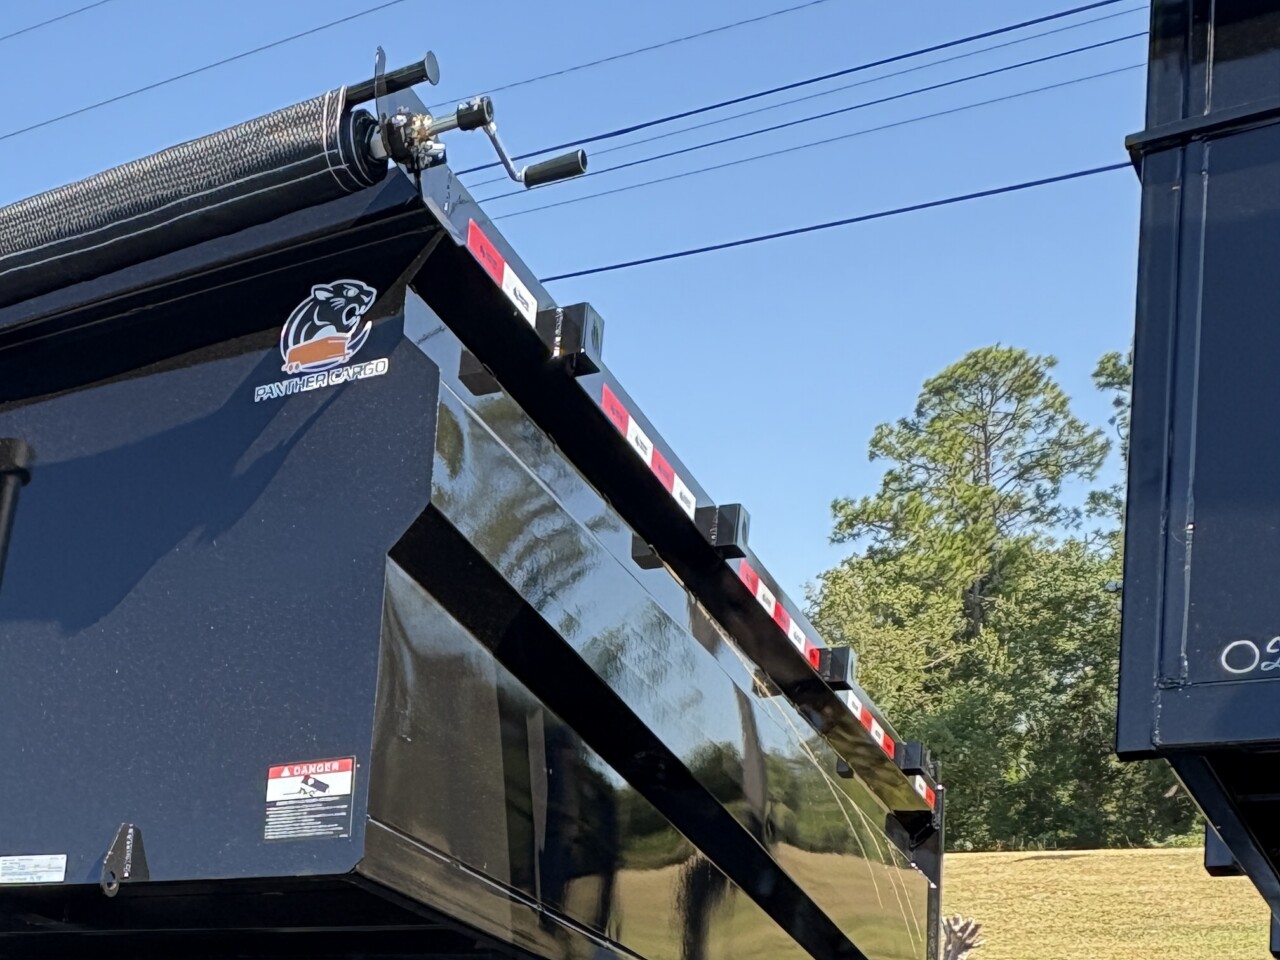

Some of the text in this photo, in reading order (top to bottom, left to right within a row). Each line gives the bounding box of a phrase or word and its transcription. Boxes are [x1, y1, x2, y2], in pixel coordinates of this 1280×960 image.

[254, 358, 389, 402] PANTHER CARGO
[293, 761, 339, 775] DANGER
